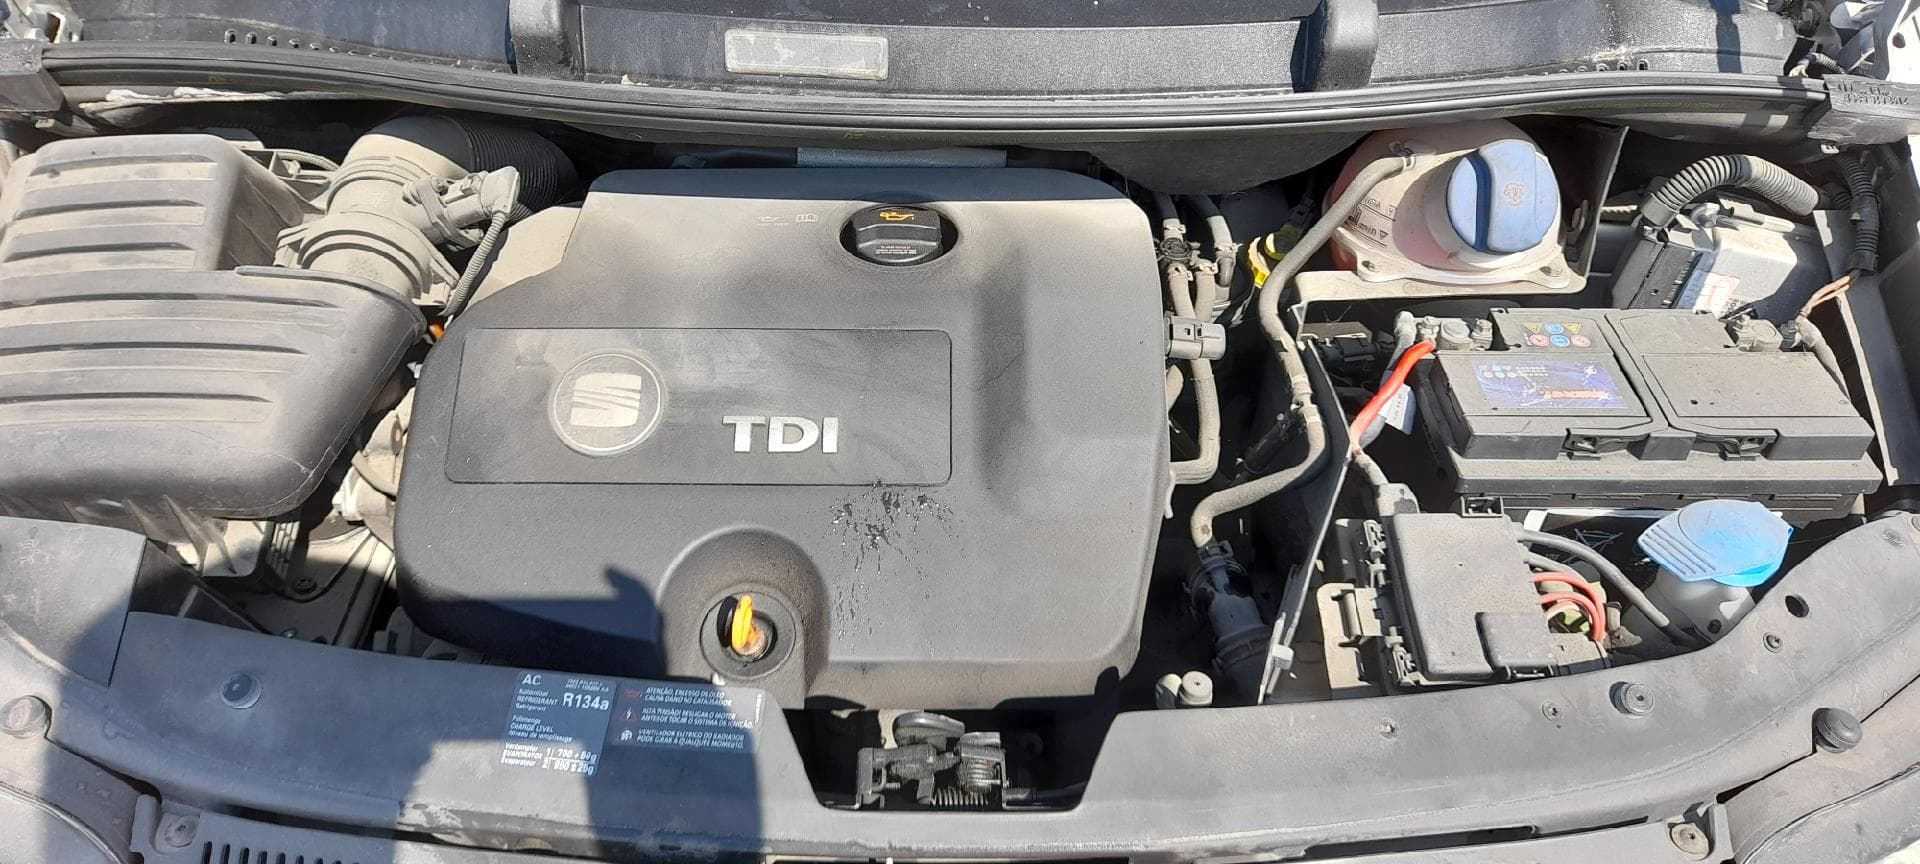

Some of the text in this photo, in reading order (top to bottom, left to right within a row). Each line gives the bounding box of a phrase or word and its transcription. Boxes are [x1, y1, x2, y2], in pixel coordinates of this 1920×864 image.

[722, 415, 839, 453] TDI
[522, 674, 541, 685] AC
[517, 695, 558, 705] REFRIGERANT
[562, 692, 610, 710] R134a
[715, 712, 736, 720] MOTOR
[510, 723, 554, 733] CHARGE LEVEL
[713, 733, 744, 741] RADIADOR
[503, 750, 543, 759] EVAPORATOR
